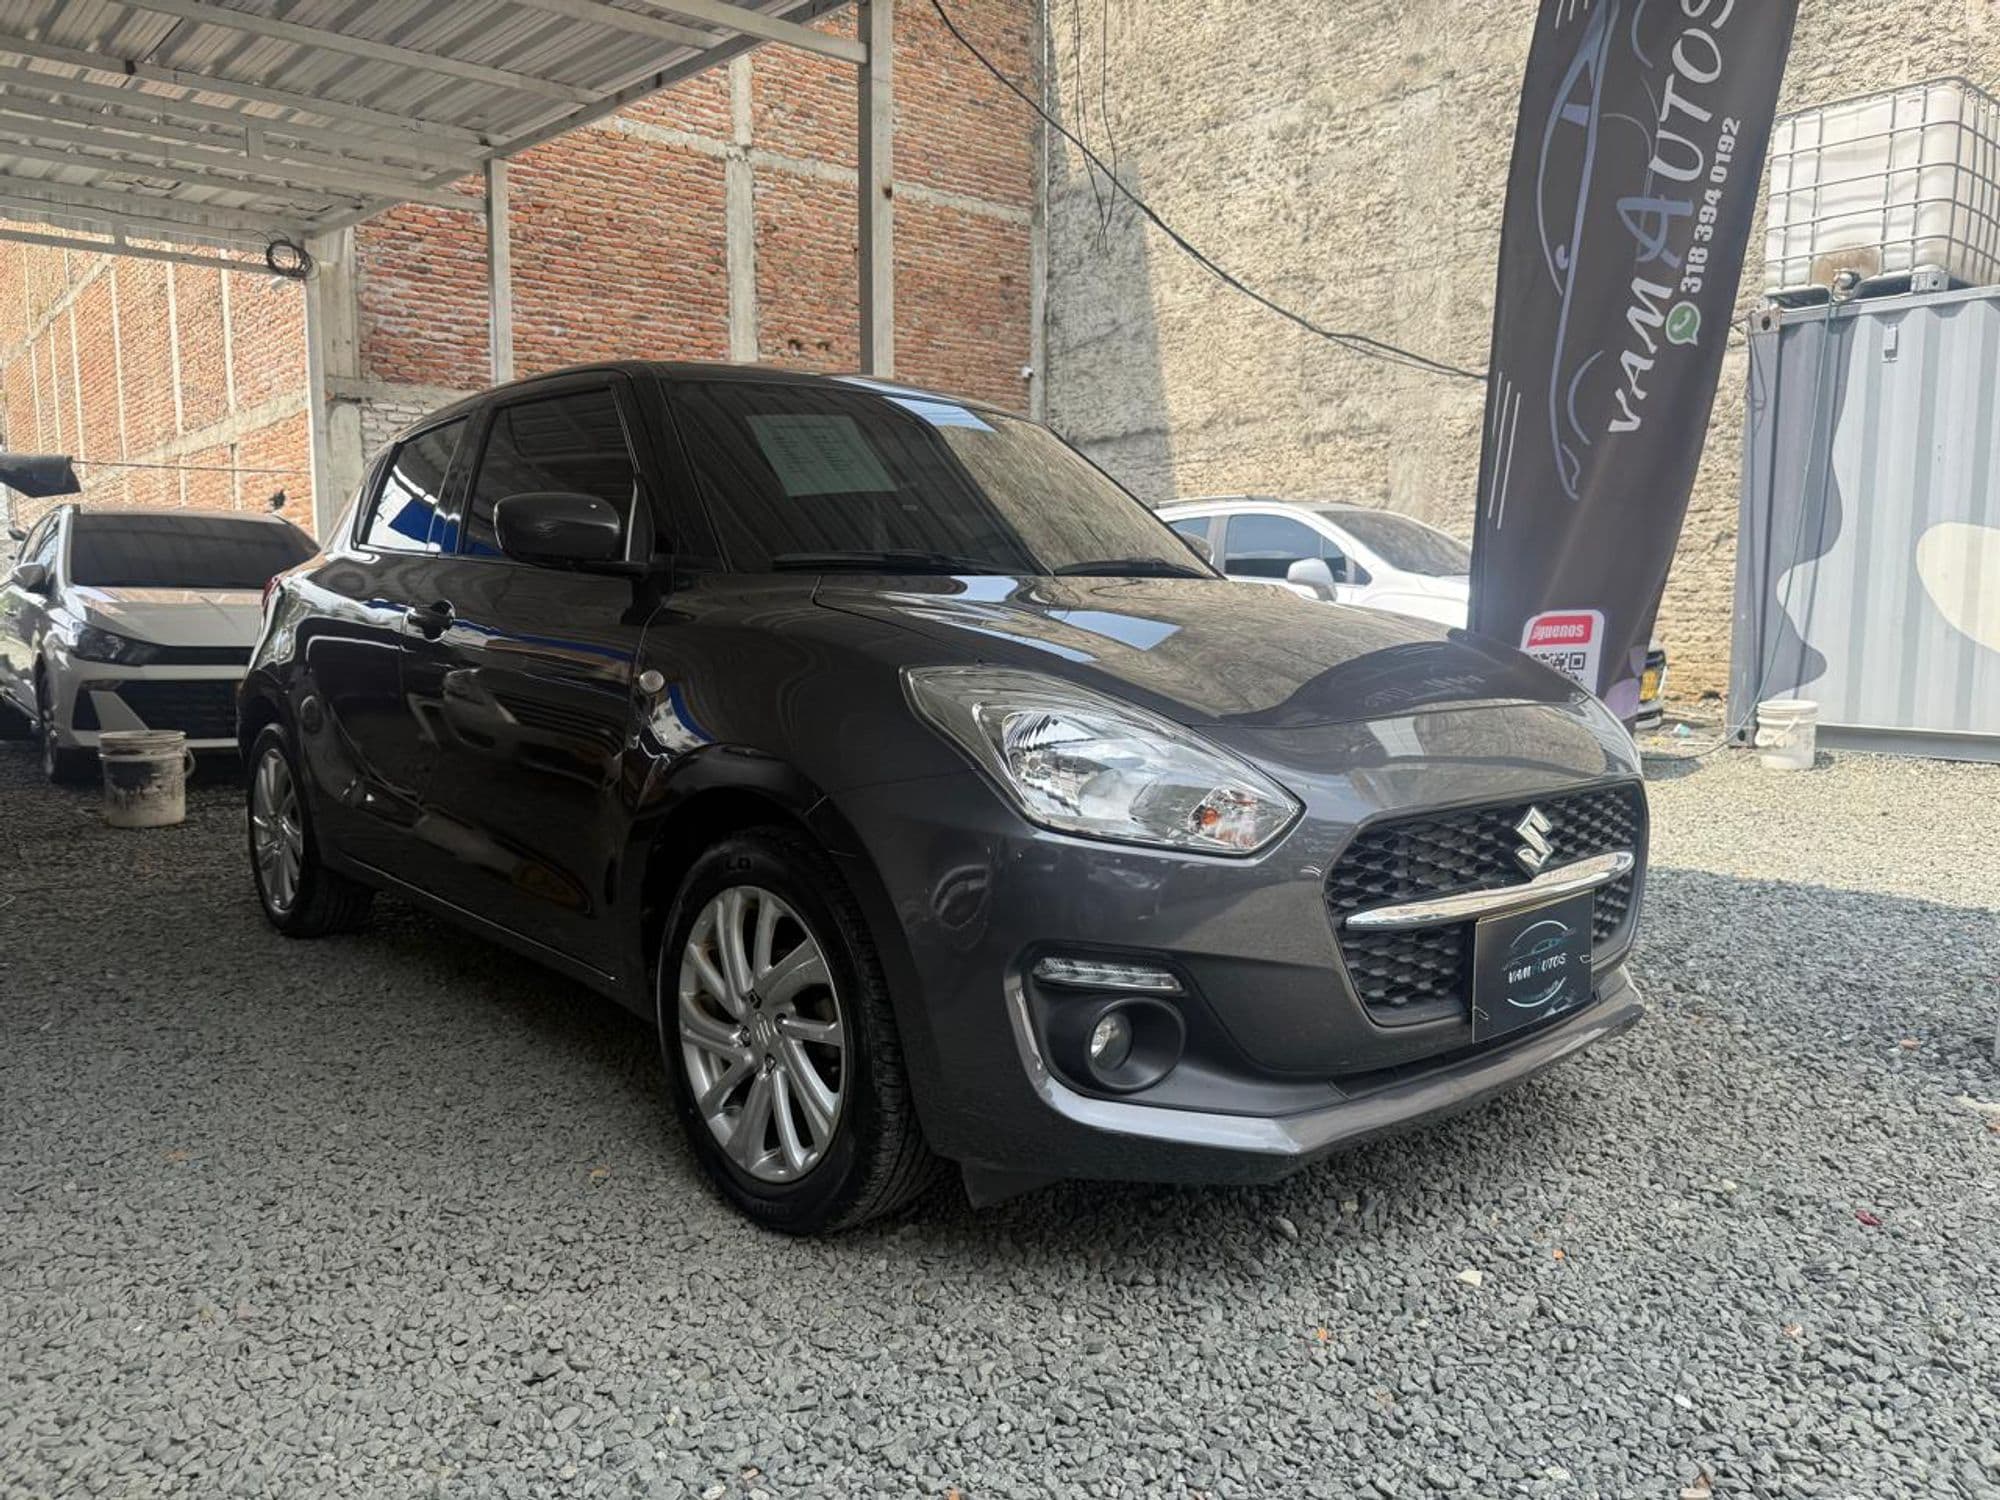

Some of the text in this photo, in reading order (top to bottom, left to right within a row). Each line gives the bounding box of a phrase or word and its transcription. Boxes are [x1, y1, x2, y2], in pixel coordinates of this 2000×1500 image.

[1680, 117, 1741, 294] 318 394 0192
